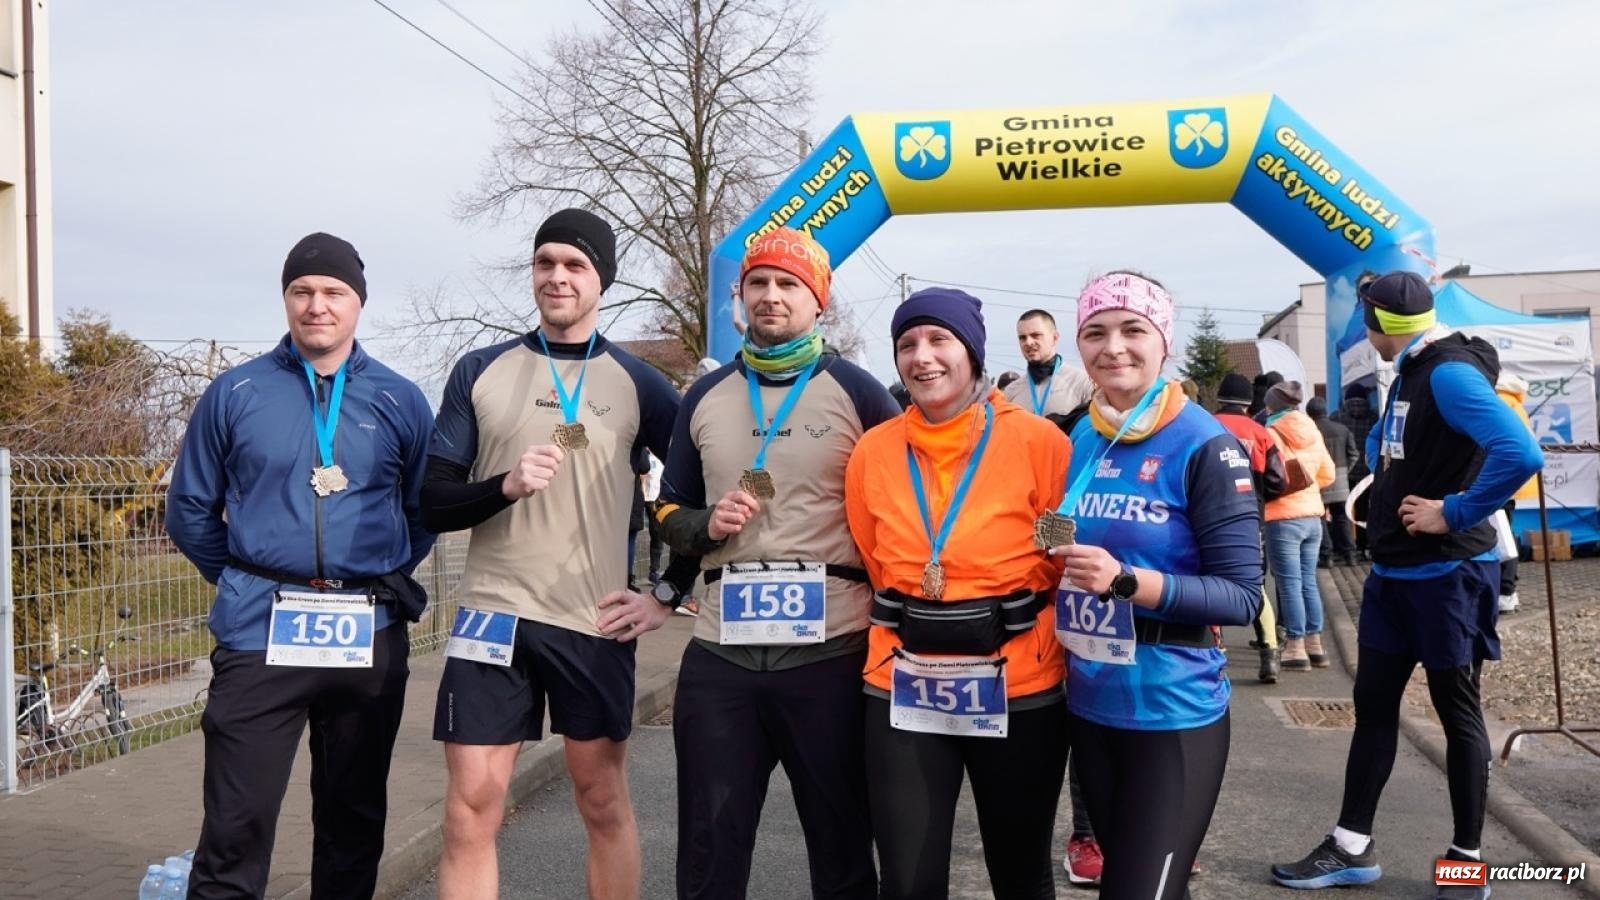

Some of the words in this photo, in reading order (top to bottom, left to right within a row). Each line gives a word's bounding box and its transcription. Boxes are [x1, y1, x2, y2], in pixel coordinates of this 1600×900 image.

[1003, 115, 1114, 131] Gmina
[975, 132, 1146, 157] Pietrowice
[800, 145, 853, 197] ludzi
[996, 157, 1122, 181] Wielkie
[1275, 126, 1342, 186] Gmina
[1341, 179, 1401, 231] ludzi
[797, 168, 872, 241] ywnych
[1255, 152, 1374, 251] aktywnych
[1066, 492, 1170, 524] NNERS
[738, 584, 806, 618] 158
[1065, 593, 1117, 635] 162
[292, 613, 357, 645] 150
[459, 608, 495, 637] 77
[911, 678, 986, 712] 151
